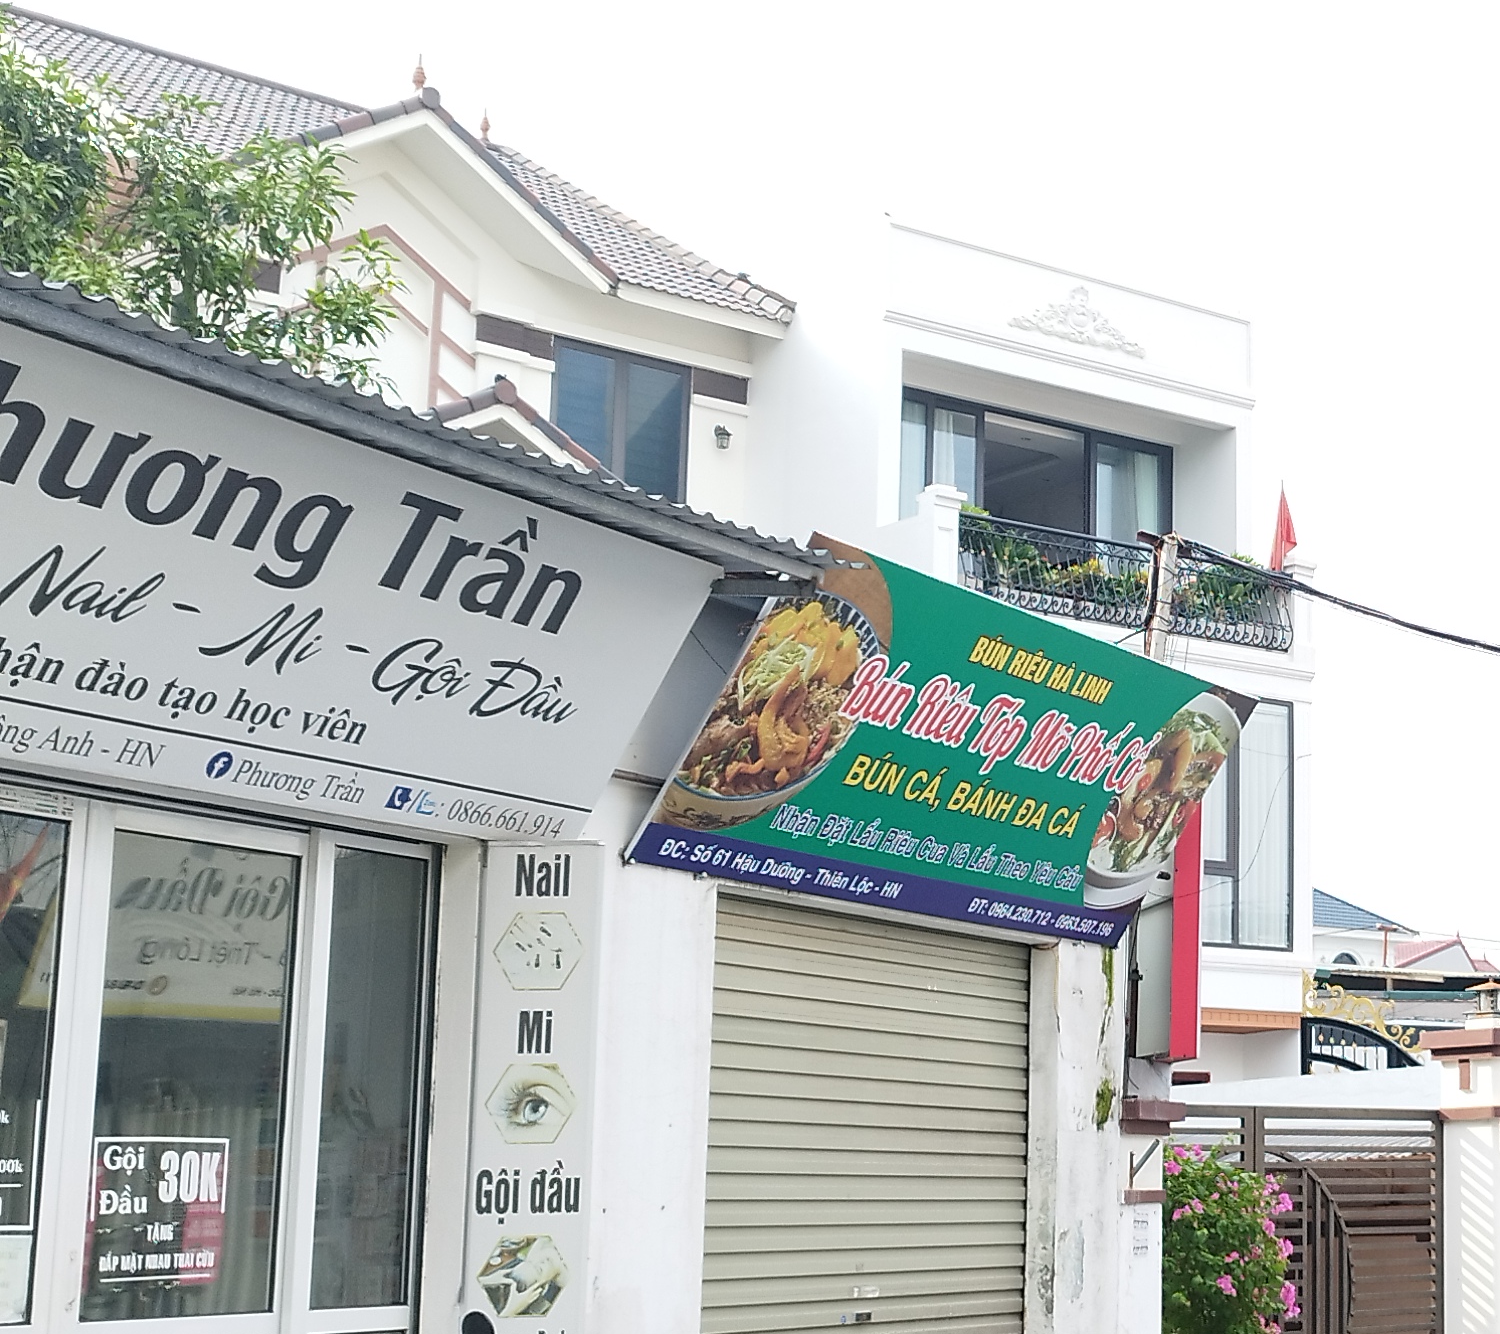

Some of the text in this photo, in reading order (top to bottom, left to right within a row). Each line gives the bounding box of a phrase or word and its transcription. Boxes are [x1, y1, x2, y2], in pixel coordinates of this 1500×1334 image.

[378, 491, 582, 634] Trần
[0, 544, 165, 623] Nail
[198, 603, 324, 675] Mi
[372, 638, 471, 706] Gội
[469, 656, 578, 724] Đầu
[968, 635, 1114, 705] BÚN RIÊU HÀ LINH
[75, 658, 148, 701] đào
[158, 677, 218, 719] tạo
[223, 687, 291, 733] học
[303, 707, 367, 745] viên
[838, 653, 914, 730] Bún
[903, 673, 981, 748] Riêu
[1015, 709, 1074, 772] Mỡ
[1057, 721, 1136, 784] Phố
[36, 726, 95, 758] Anh
[116, 738, 166, 769] HN
[231, 759, 365, 804] Phương Trần
[843, 752, 1087, 838] BÚN CÁ, BÁNH ĐA CÁ
[447, 799, 566, 839] 0866.661.914
[770, 803, 820, 839] Nhận
[817, 813, 853, 846] Đặt
[881, 827, 917, 857] Riêu
[916, 836, 949, 864] Cua
[948, 841, 970, 868] Và
[994, 852, 1032, 881] Theo
[1029, 859, 1055, 890] Yêu
[515, 854, 571, 897] Nail
[658, 838, 690, 860] ĐC:
[690, 843, 717, 864] Số
[711, 849, 730, 867] 61
[731, 852, 760, 875] Hậu
[760, 858, 805, 885] Dưỡng
[813, 868, 849, 891] Thiên
[849, 874, 874, 896] Lộc
[880, 881, 903, 899] HN
[968, 898, 988, 915] ĐT:
[517, 1010, 553, 1054] Mi
[103, 1145, 145, 1176] Gội
[158, 1150, 222, 1204] 30K
[99, 1184, 148, 1216] Đầu
[475, 1160, 581, 1225] Gội đầu
